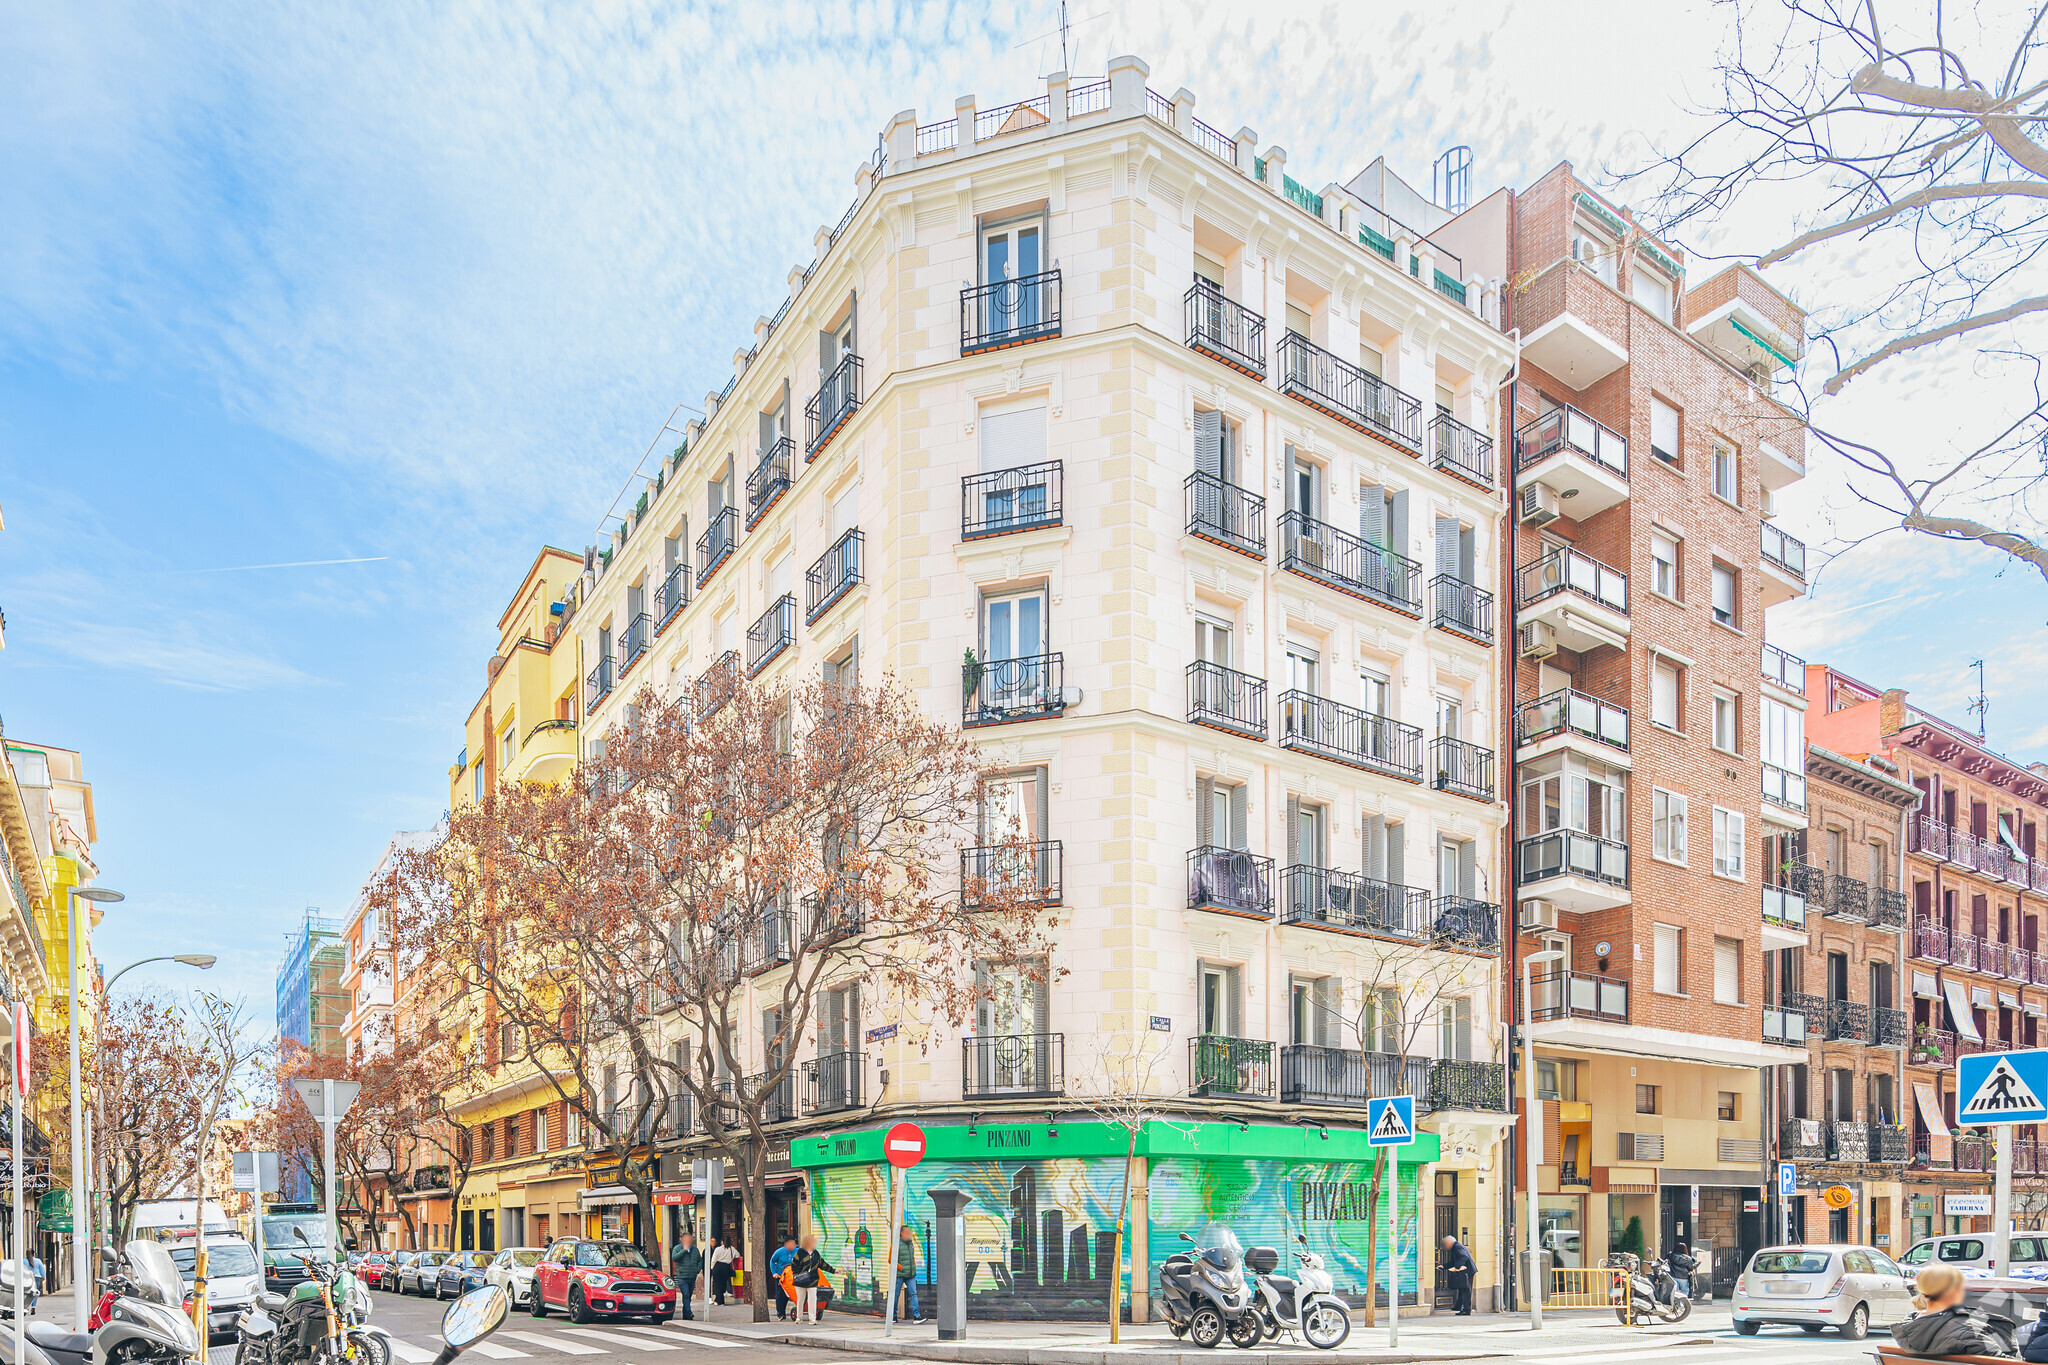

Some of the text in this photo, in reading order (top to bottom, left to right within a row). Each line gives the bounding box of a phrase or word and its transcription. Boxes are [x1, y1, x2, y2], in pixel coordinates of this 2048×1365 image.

[835, 1138, 857, 1156] PINZANO
[987, 1130, 1031, 1147] PINZANO
[1227, 1183, 1248, 1191] SABOR
[1782, 1167, 1793, 1193] P
[1228, 1204, 1247, 1212] CERO
[1302, 1182, 1368, 1221] PINZANO
